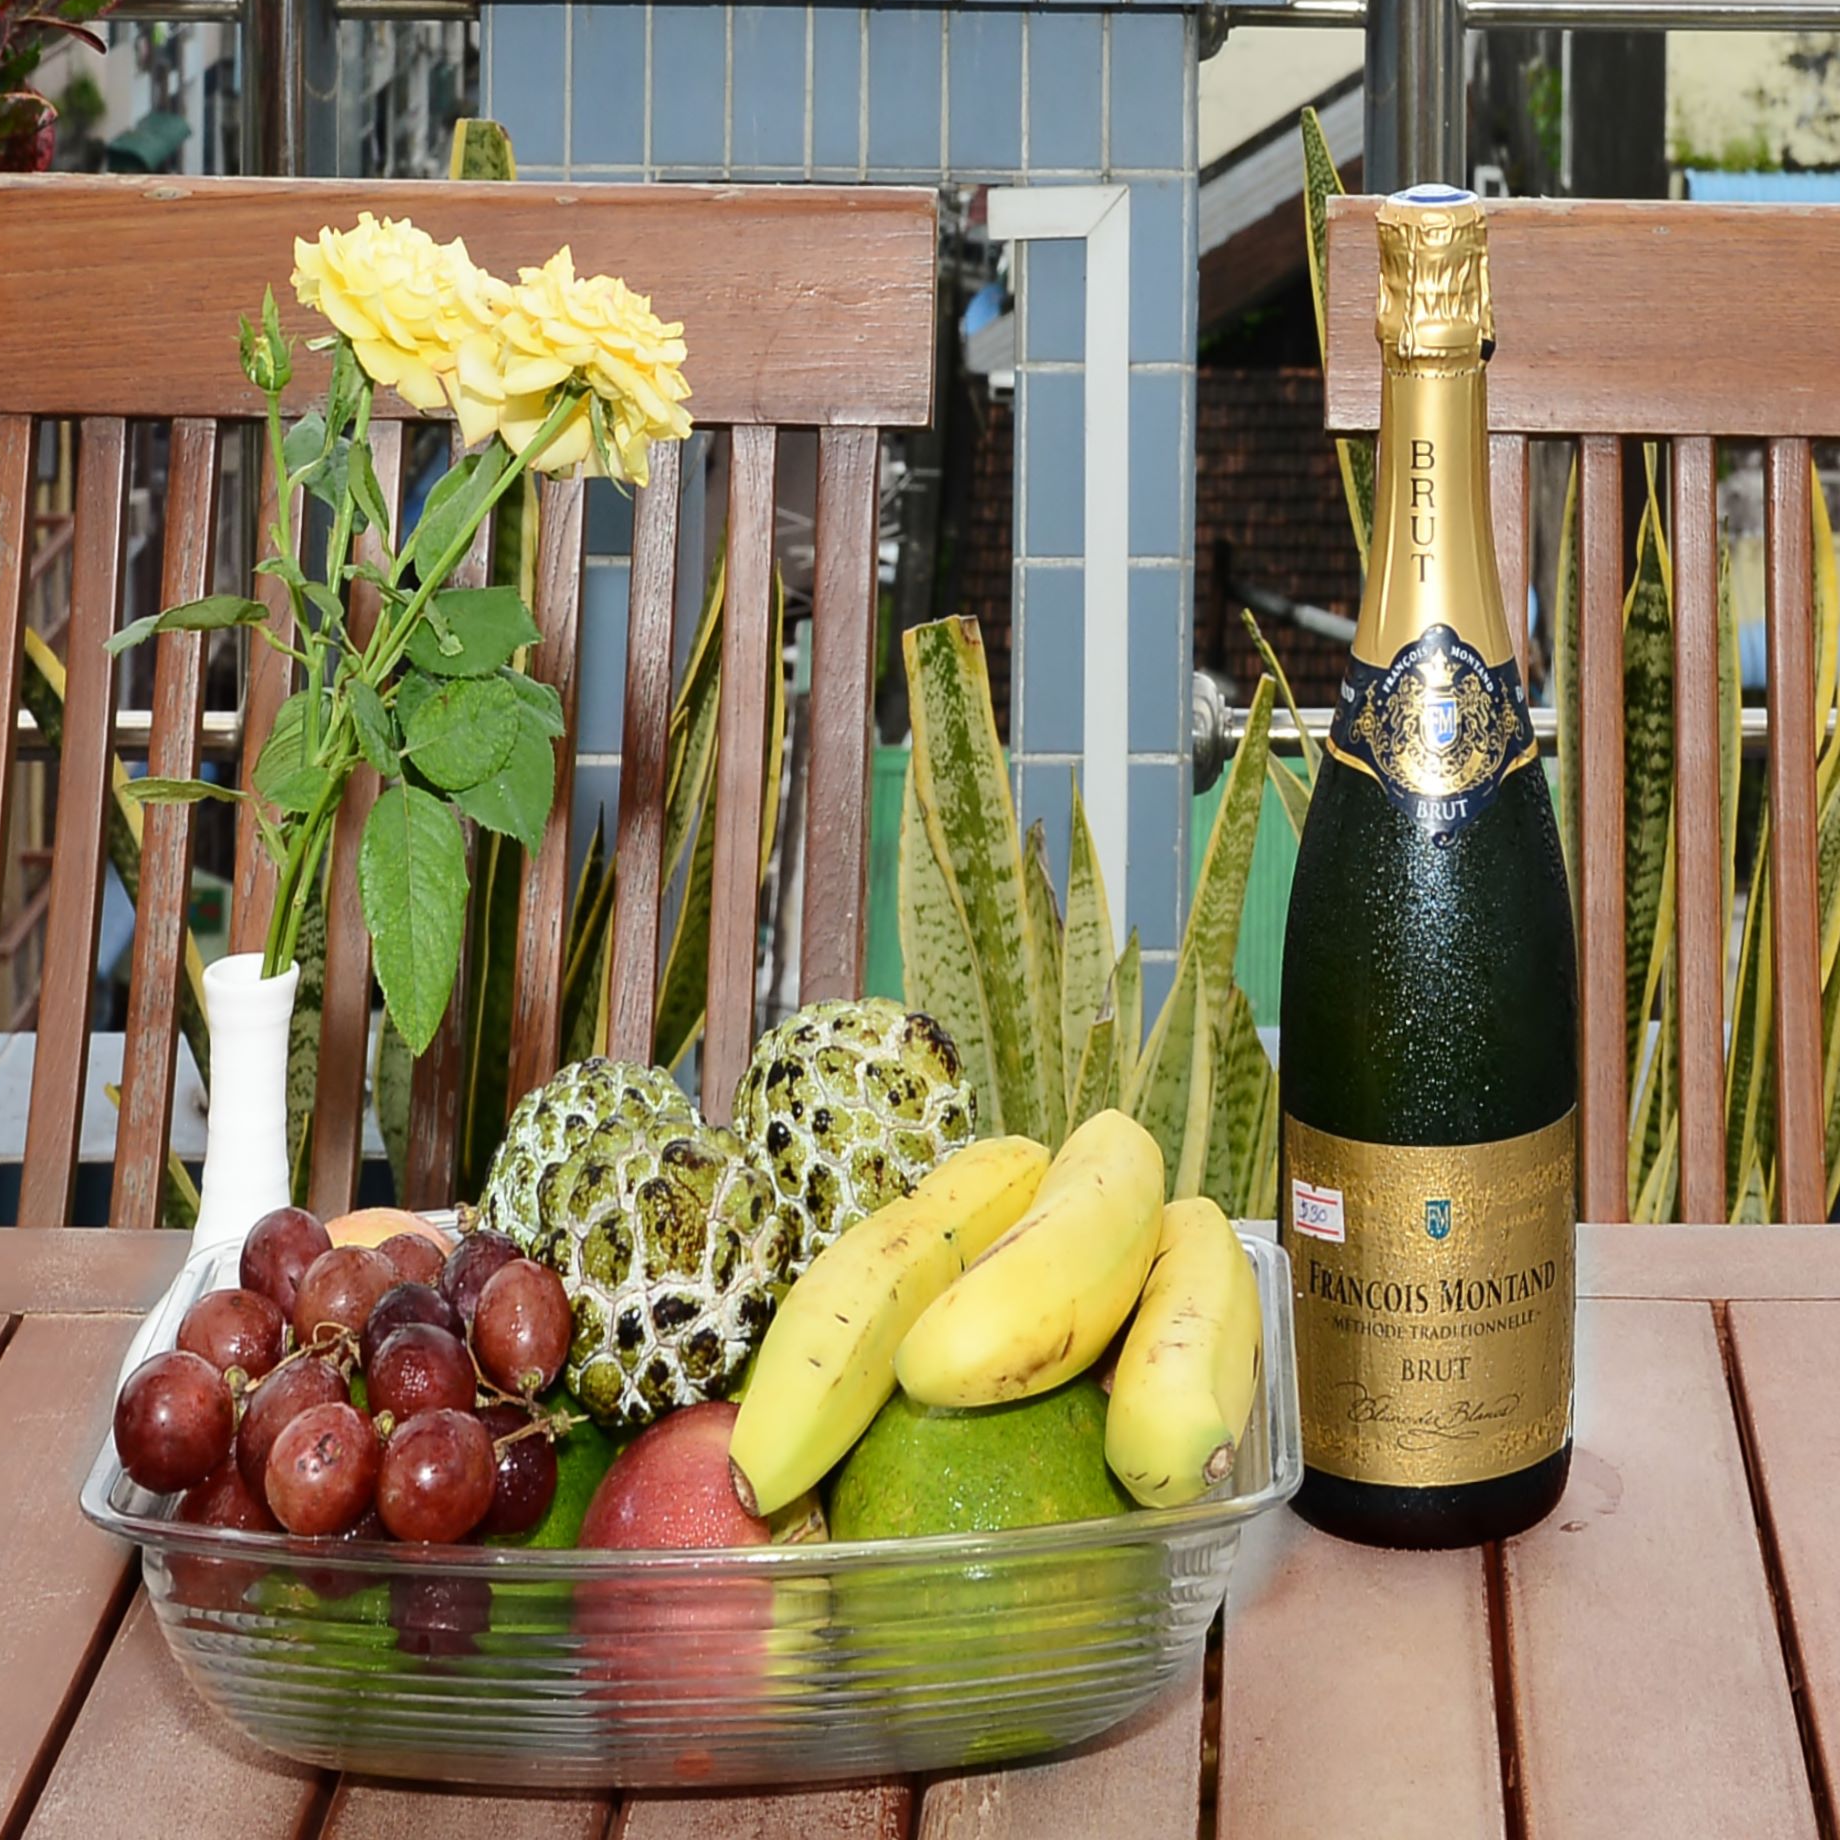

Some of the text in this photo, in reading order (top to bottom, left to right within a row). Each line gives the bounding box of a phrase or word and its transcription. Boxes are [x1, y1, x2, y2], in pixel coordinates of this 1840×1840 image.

[1410, 439, 1435, 583] BRUT
[1382, 646, 1429, 693] FRANÇOIS
[1450, 645, 1494, 693] MONTAND
[1416, 798, 1469, 820] BRUT
[1309, 1259, 1556, 1318] FRANÇOIS MONTAND
[1410, 1311, 1537, 1341] TRADITIONNELLE
[1400, 1356, 1473, 1382] BRUT
